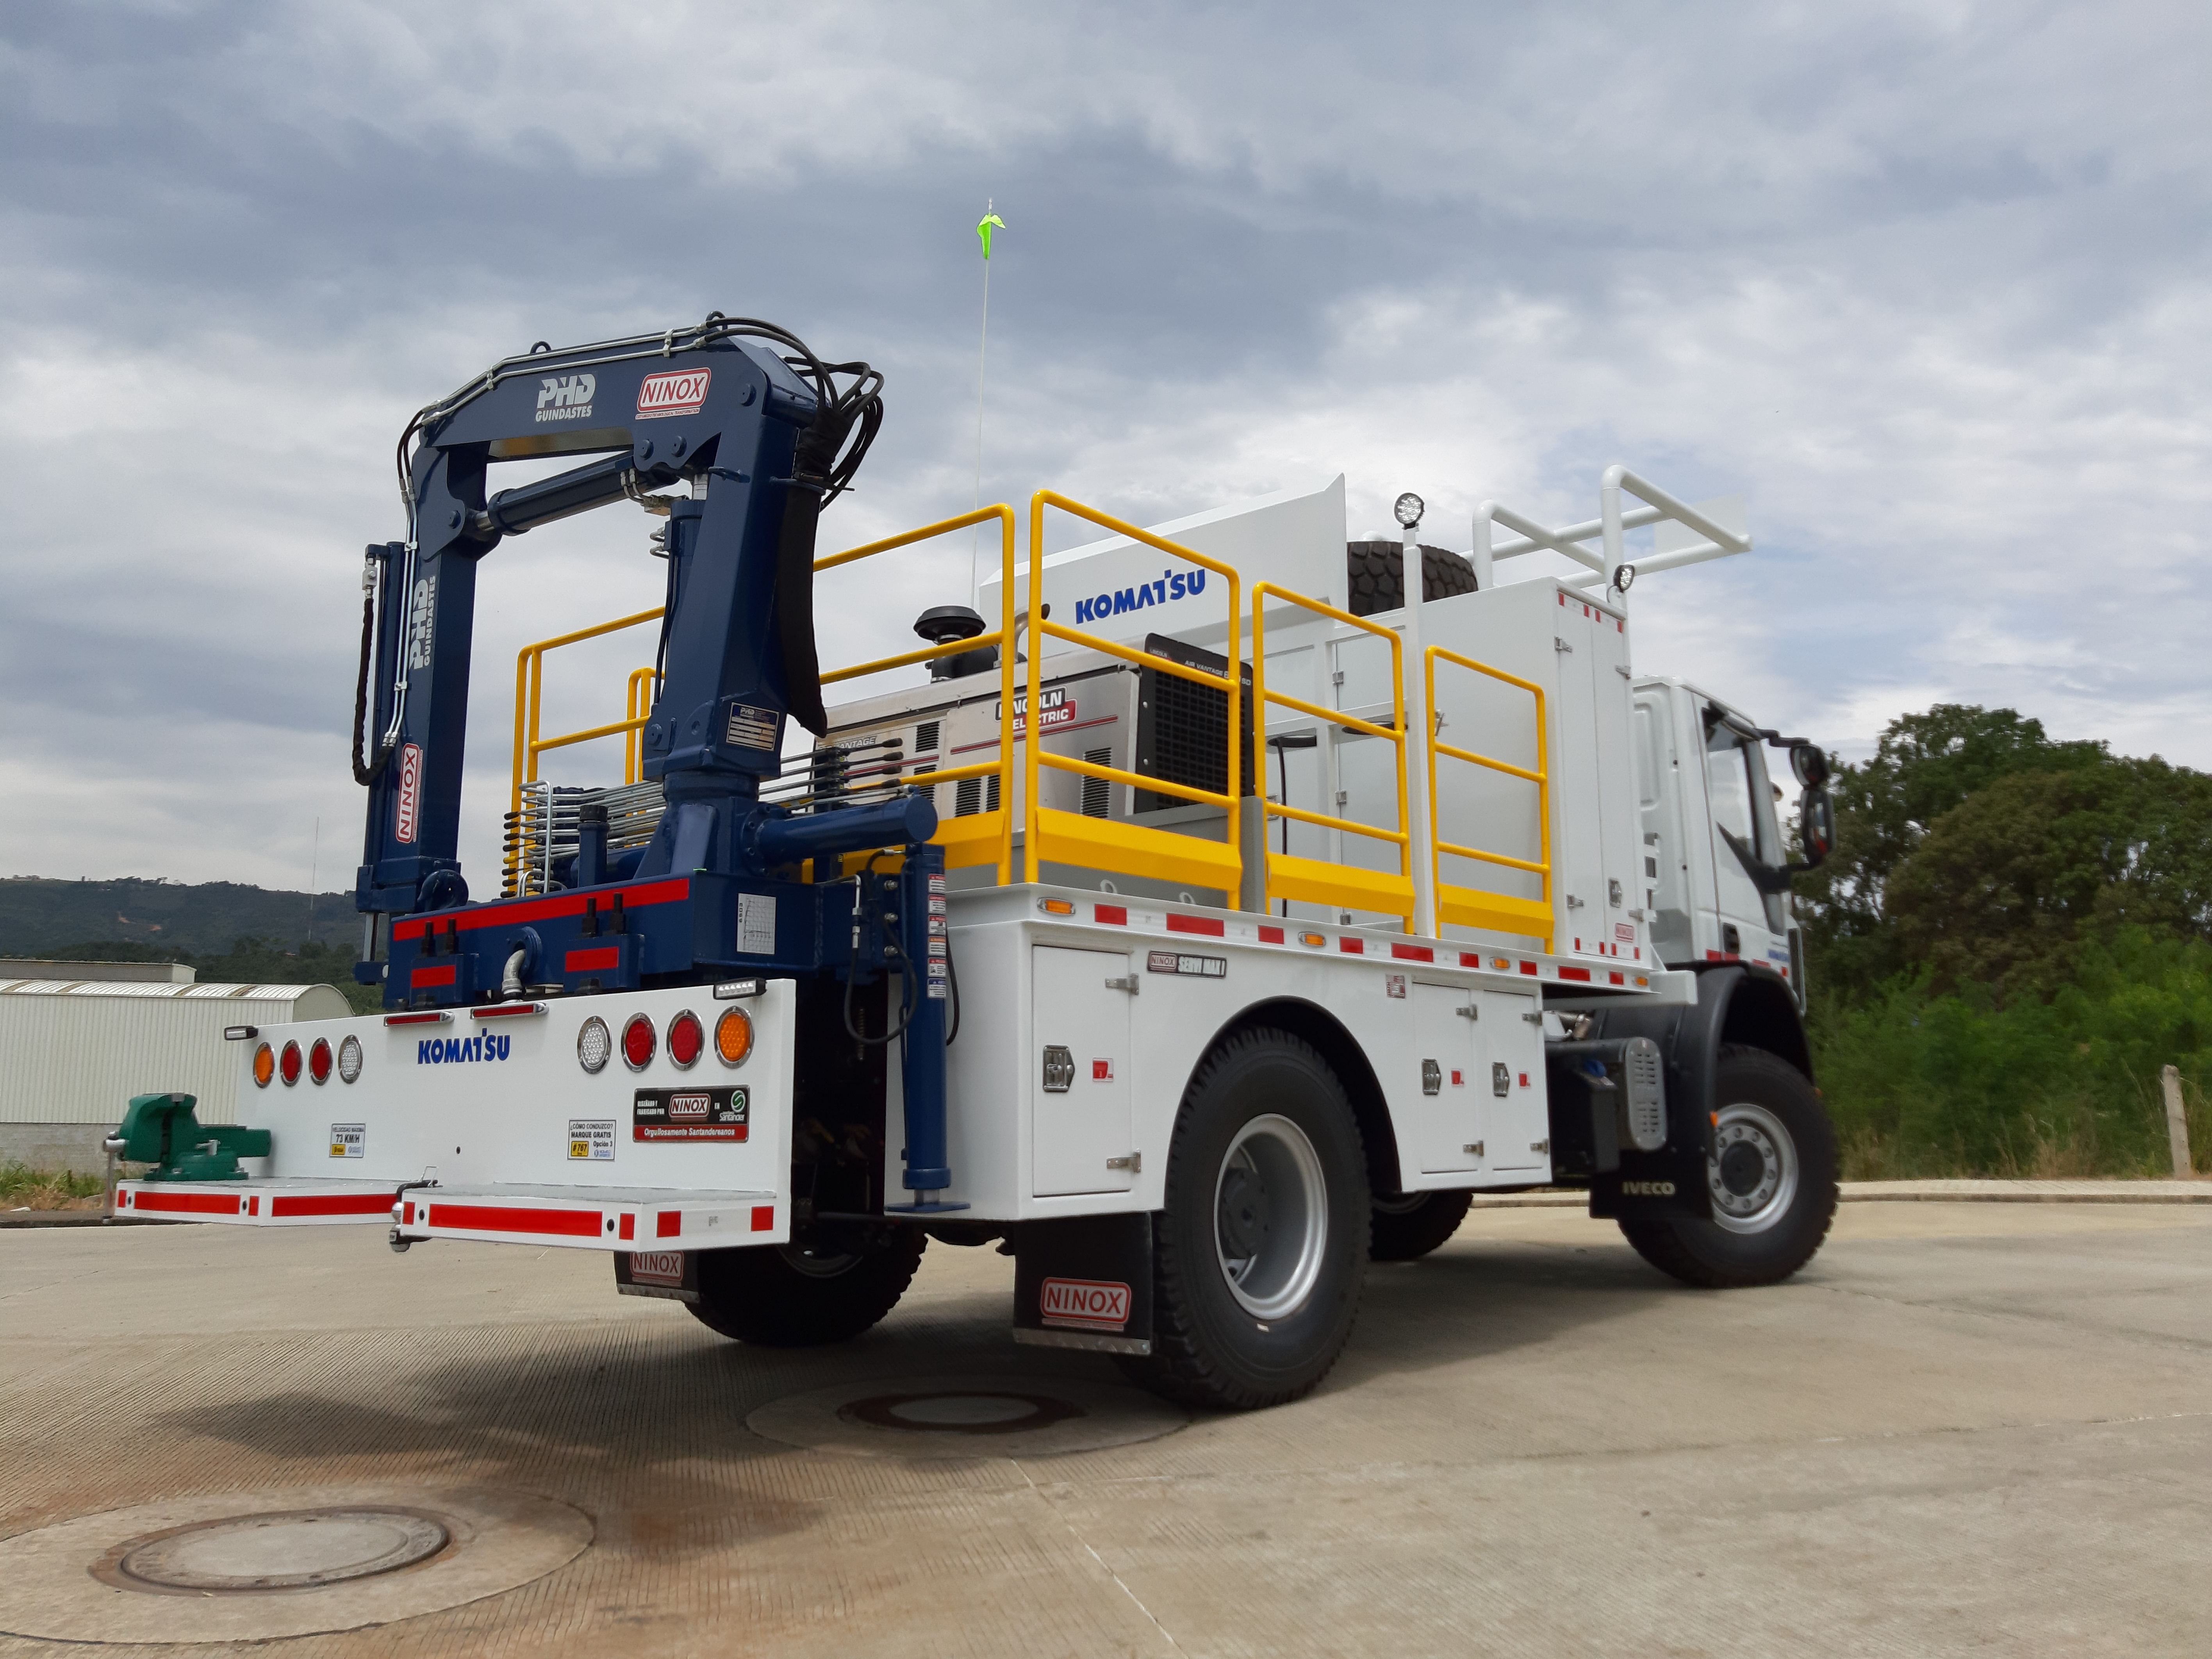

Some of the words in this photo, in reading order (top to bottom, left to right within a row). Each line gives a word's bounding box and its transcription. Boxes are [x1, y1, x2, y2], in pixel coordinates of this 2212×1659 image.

[537, 374, 596, 409] PHD
[642, 377, 705, 403] NINOX
[535, 405, 592, 422] GUINDASTES
[1075, 569, 1206, 624] KOMATSU
[409, 579, 428, 670] PHD
[424, 575, 436, 666] GUINDASTES
[1184, 660, 1195, 668] AIR
[1196, 664, 1223, 676] VANTAGE
[400, 752, 416, 836] NINOX
[1152, 956, 1175, 965] NINOX
[418, 1028, 510, 1064] KOMATSU
[672, 1099, 707, 1112] NINOX
[578, 1143, 587, 1152] 767
[1623, 1182, 1675, 1194] IVECO
[634, 1252, 679, 1274] NINOX
[1047, 1287, 1123, 1314] NINOX
